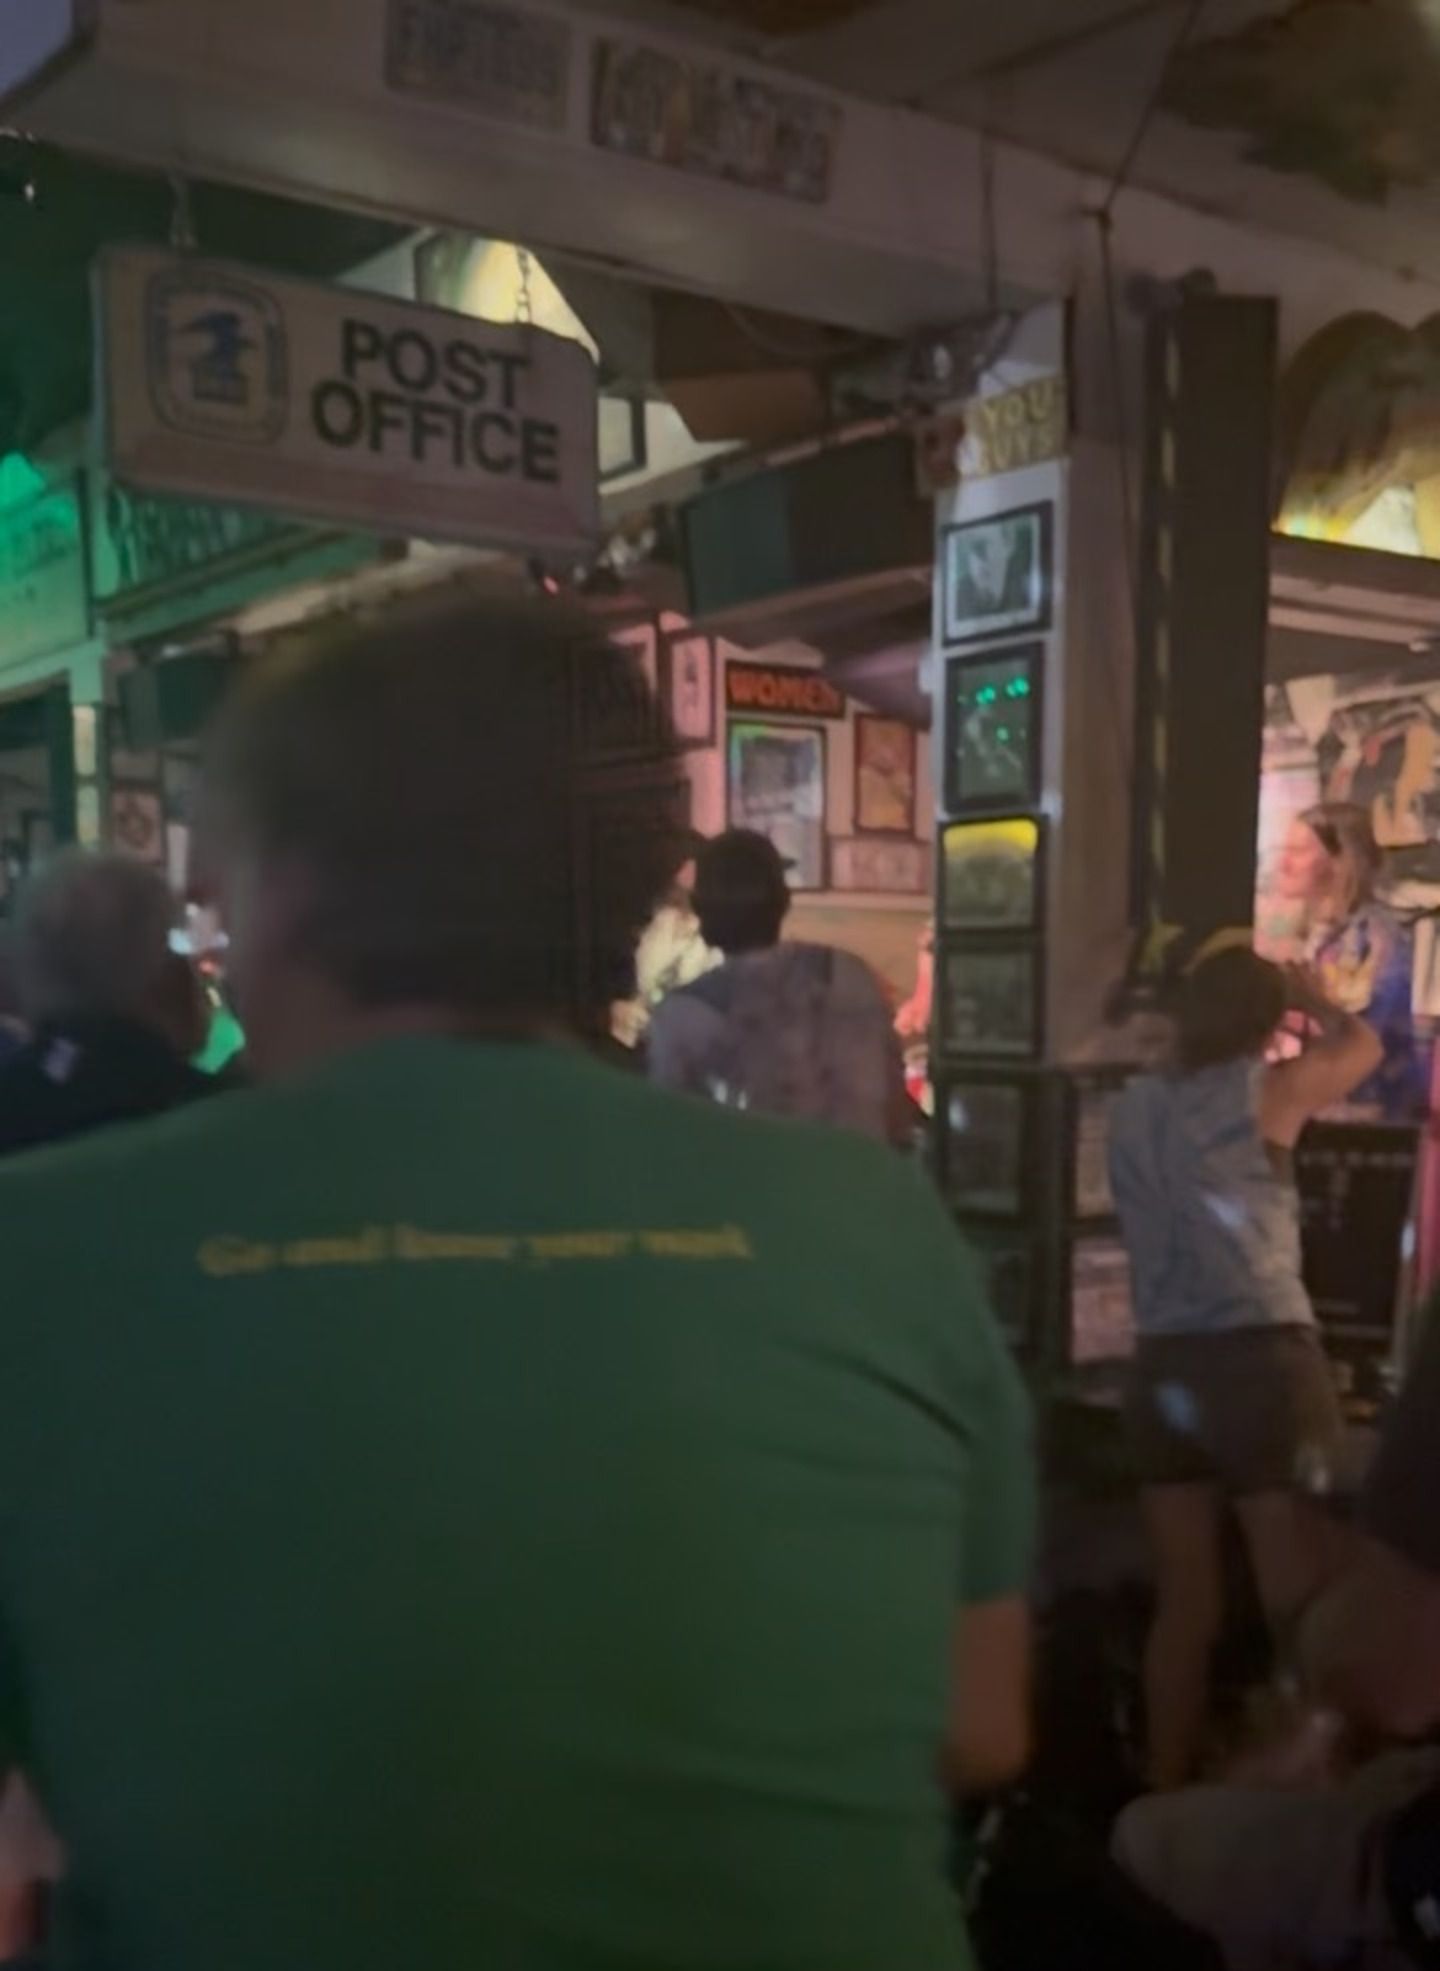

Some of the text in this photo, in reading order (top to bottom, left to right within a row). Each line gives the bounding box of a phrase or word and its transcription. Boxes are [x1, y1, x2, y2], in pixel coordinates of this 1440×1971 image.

[342, 317, 530, 409] POST
[984, 380, 1058, 431] YOU
[311, 379, 561, 482] OFFICE
